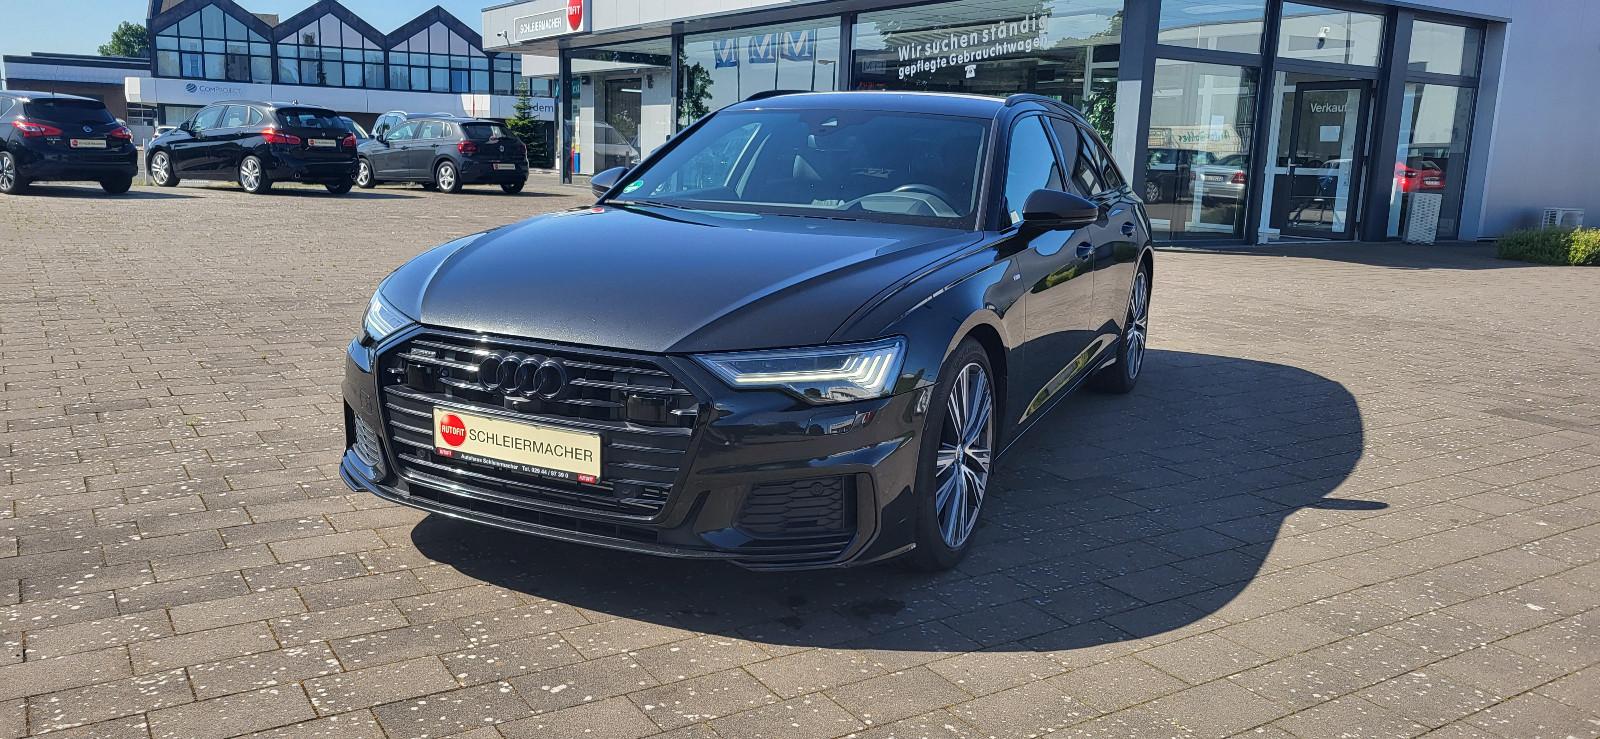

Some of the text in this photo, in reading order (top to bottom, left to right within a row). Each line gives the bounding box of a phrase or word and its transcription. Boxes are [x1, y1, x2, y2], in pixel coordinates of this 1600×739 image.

[898, 13, 1048, 62] Wir suchen ständig
[898, 55, 947, 80] gepflegte
[949, 35, 1048, 66] Gebrauchtwagen
[1310, 102, 1348, 113] Verkauf
[441, 424, 593, 462] AUTOFIT SCHLEIERMACHER
